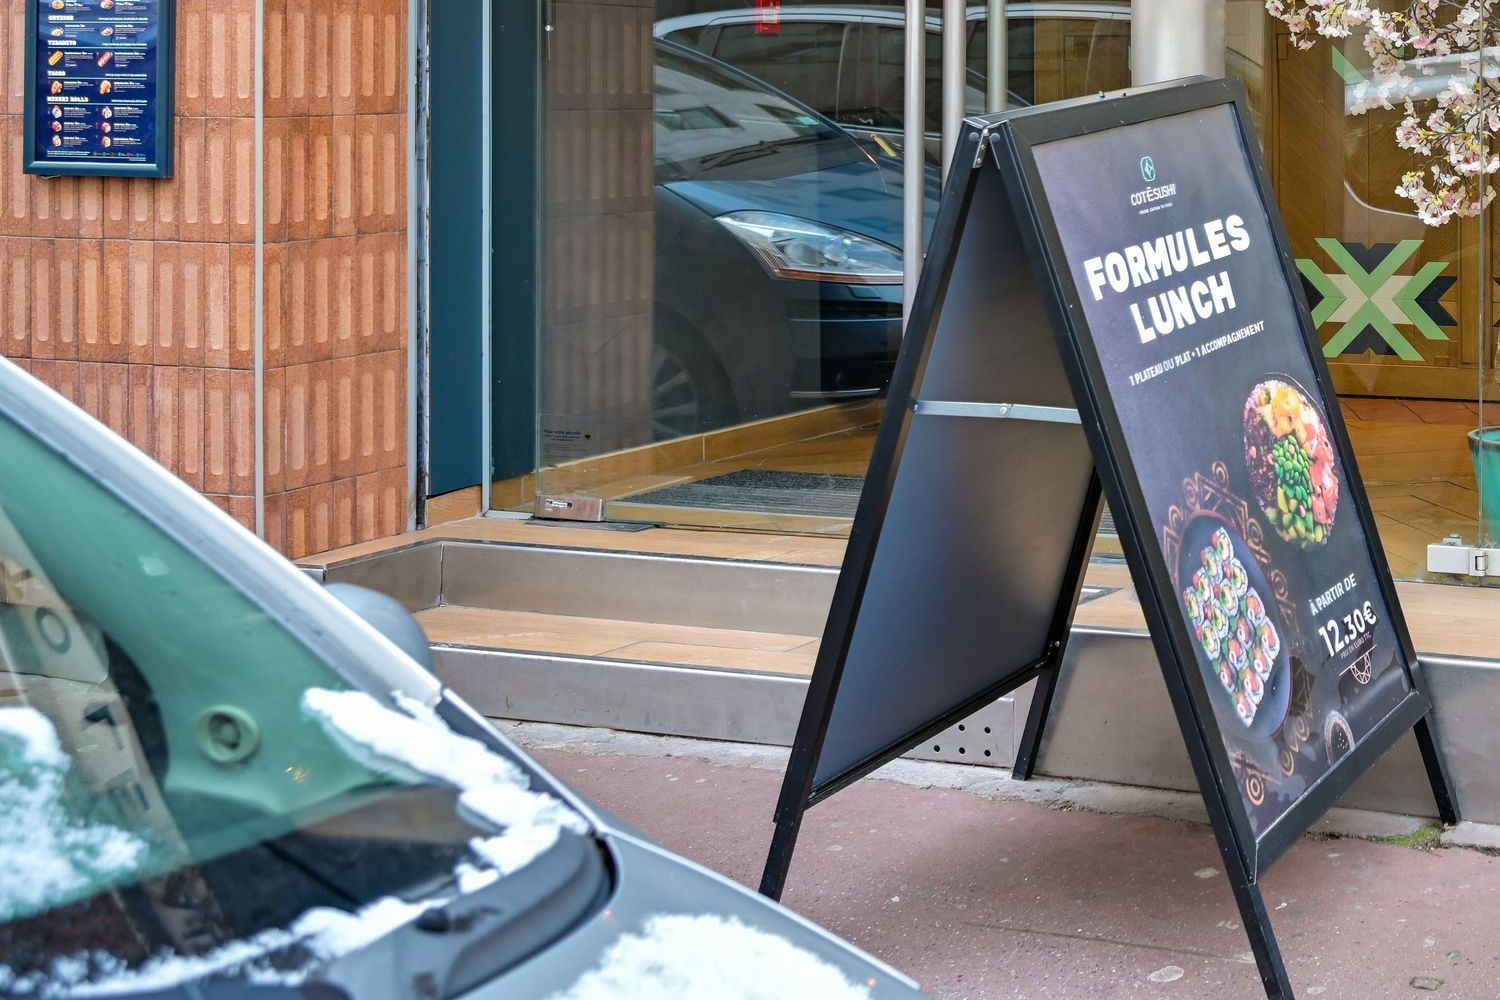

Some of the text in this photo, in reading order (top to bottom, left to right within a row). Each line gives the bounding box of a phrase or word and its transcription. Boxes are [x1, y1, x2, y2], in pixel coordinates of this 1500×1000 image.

[1083, 214, 1251, 301] FORMULES
[1129, 271, 1237, 344] LUNCH
[1129, 320, 1265, 386] 1 PLATEAU OU PLAT 1 ACCOMPAGNEMENT
[1315, 582, 1345, 611] PARTIR
[1343, 572, 1357, 591] DE
[1318, 600, 1377, 658] 12.30€
